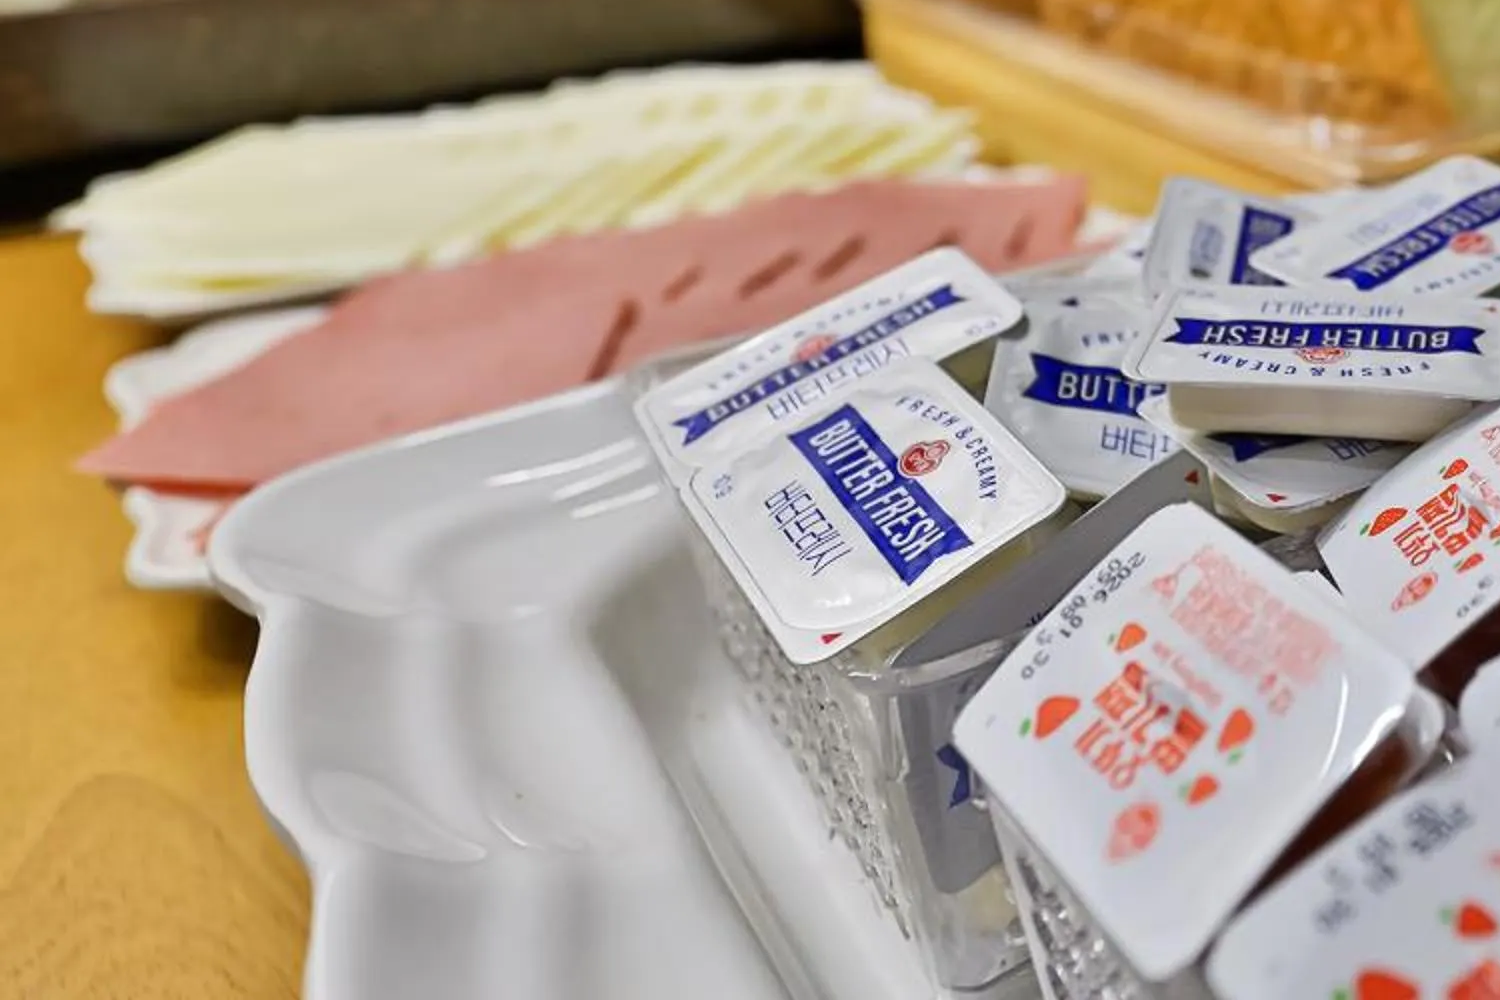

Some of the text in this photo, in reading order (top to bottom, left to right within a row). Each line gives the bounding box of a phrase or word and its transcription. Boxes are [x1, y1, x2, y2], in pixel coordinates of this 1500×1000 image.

[705, 348, 831, 423] BUTTER
[835, 295, 937, 358] FRESH
[764, 333, 912, 423] 버터프레시
[1195, 350, 1429, 377] FRESH & CREAMY
[1202, 323, 1450, 349] BUTTER FRESH
[807, 417, 947, 563] BUTTER FRESH
[894, 394, 998, 503] FRESH & CREAMY
[761, 479, 852, 577] 버터프레시
[1391, 519, 1439, 569] 오뚜기
[1414, 481, 1489, 556] 딸기쨈
[1071, 716, 1148, 795] 오뚜기
[1091, 659, 1208, 777] 딸기쨈
